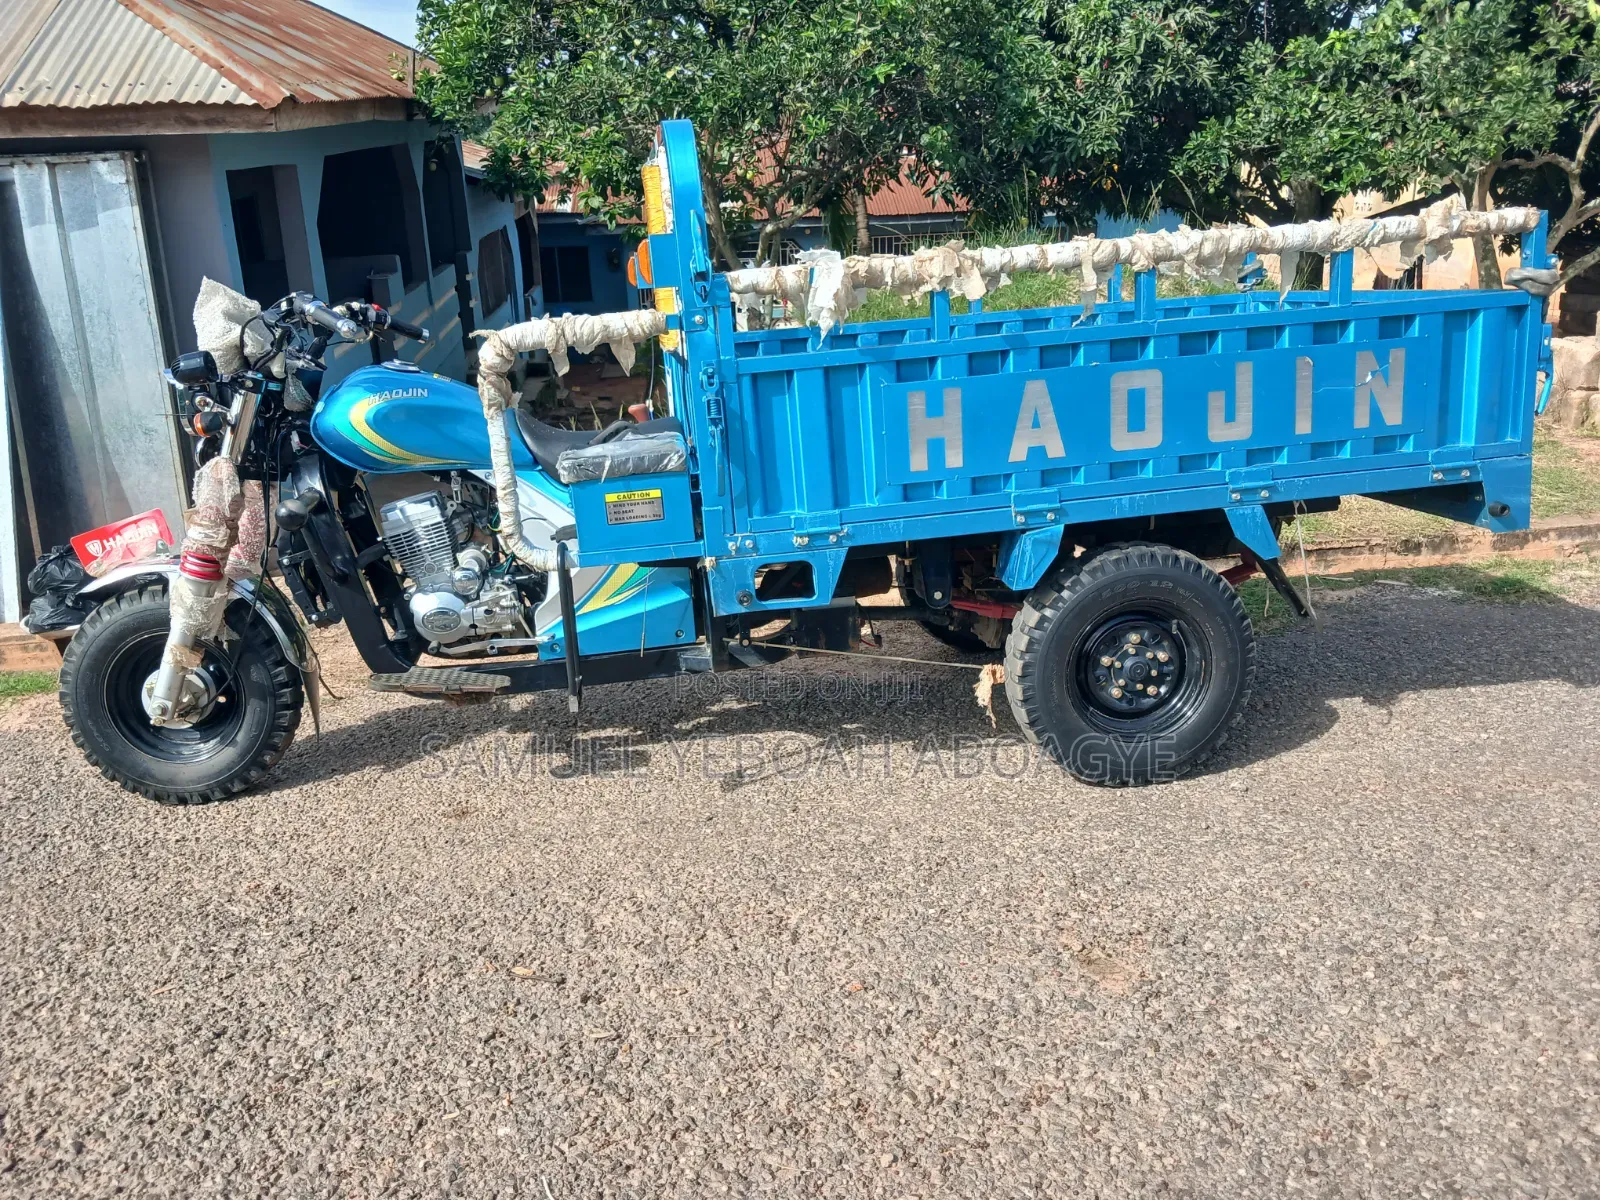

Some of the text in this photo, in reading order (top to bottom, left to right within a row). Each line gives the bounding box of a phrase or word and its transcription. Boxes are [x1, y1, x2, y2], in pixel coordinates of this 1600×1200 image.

[368, 387, 429, 406] HAOJIN
[907, 347, 1406, 472] HAOJIN
[616, 491, 651, 500] CAUTION
